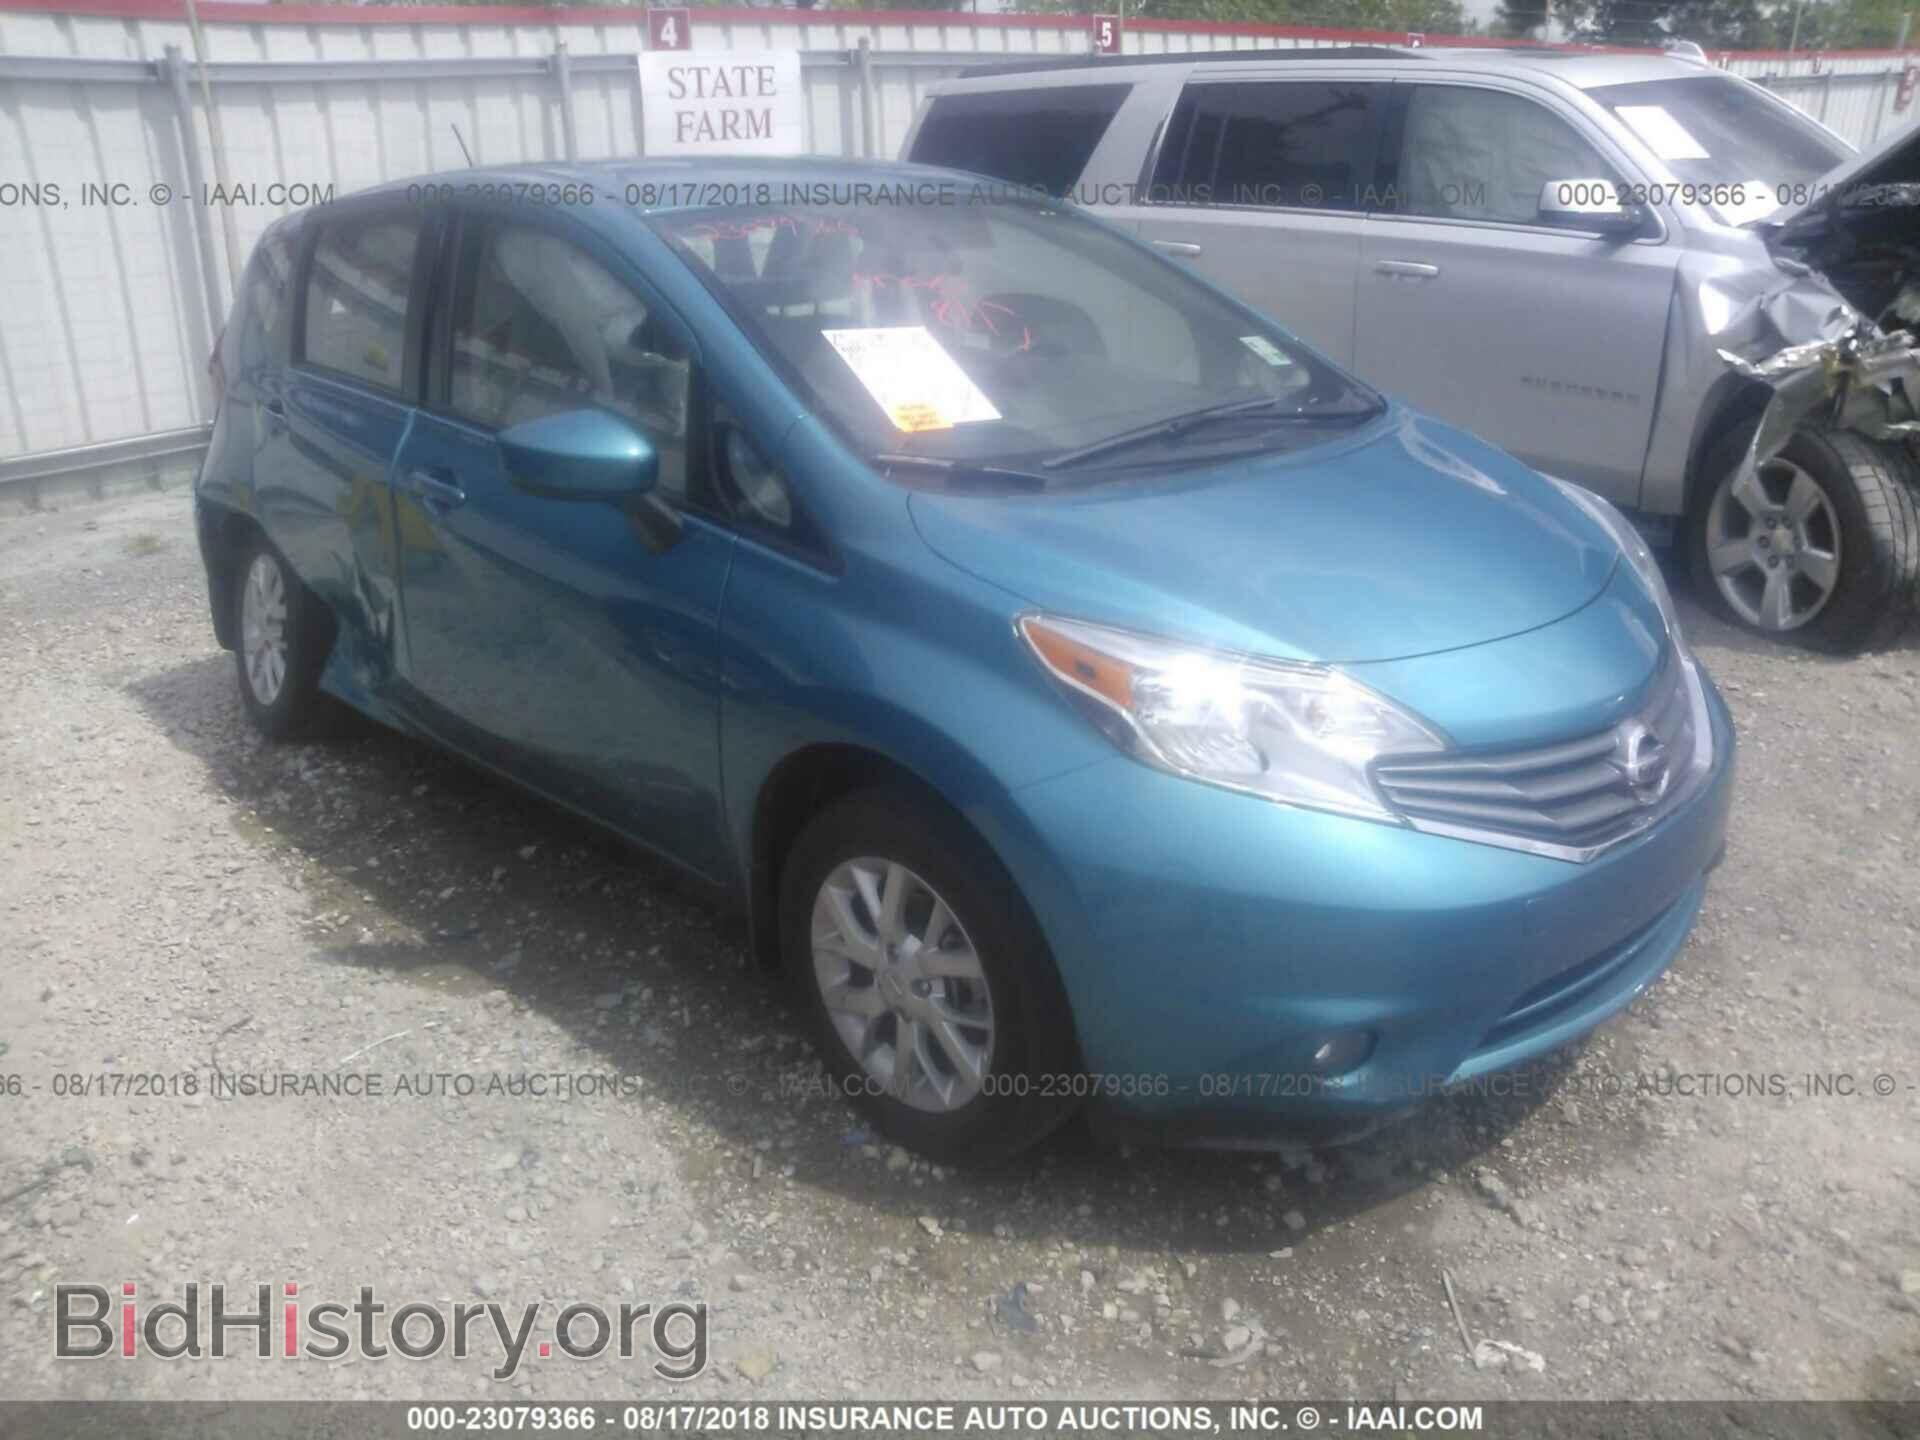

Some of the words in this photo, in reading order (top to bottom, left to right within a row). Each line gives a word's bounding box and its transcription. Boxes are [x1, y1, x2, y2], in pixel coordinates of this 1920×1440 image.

[660, 16, 678, 47] 4
[1102, 22, 1112, 48] 5
[667, 65, 777, 100] STATE
[674, 107, 774, 144] FARM
